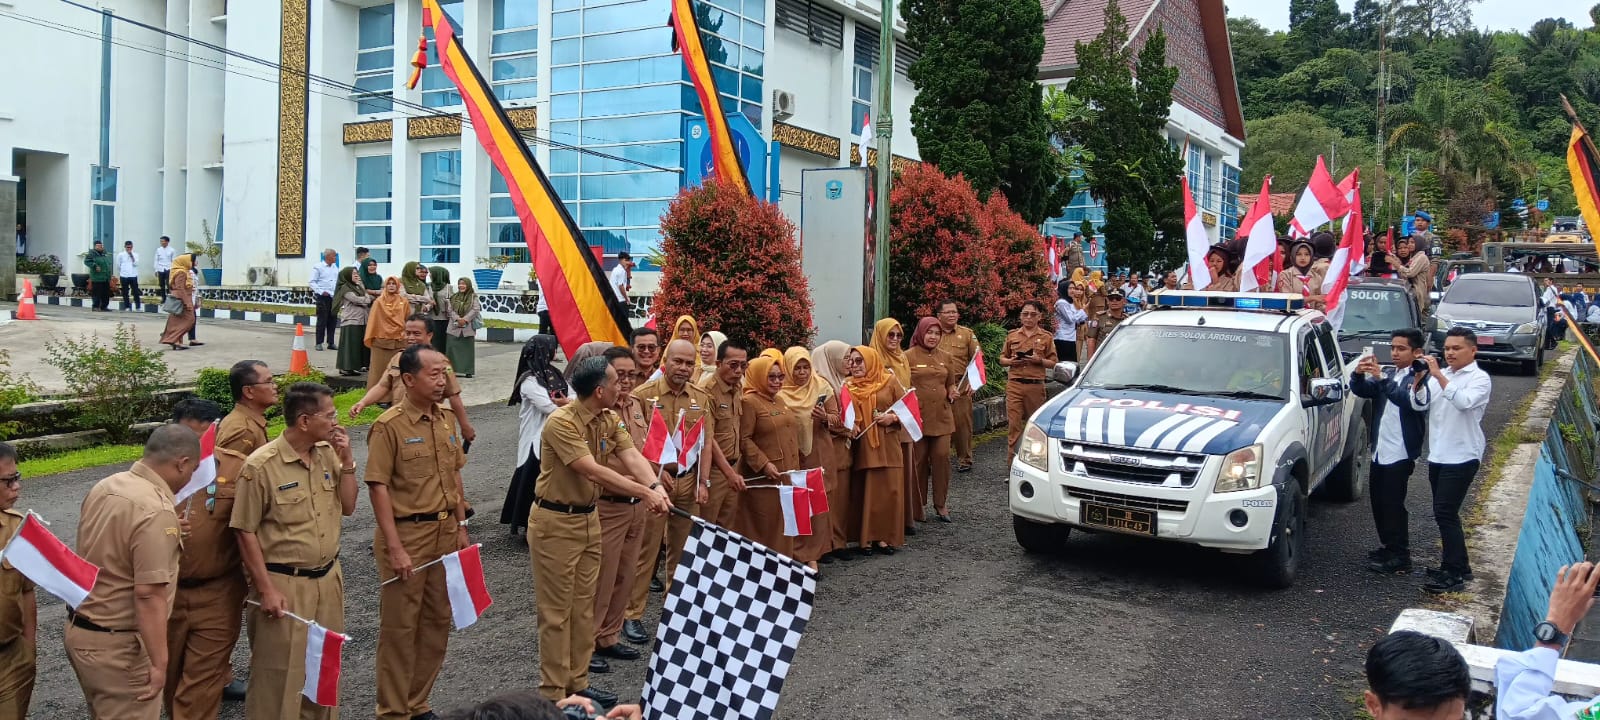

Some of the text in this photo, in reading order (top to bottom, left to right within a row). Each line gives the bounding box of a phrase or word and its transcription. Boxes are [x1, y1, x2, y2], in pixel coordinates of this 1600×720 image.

[1350, 290, 1389, 300] SOLOK
[1180, 330, 1206, 341] SOLOK
[1207, 332, 1247, 343] AROSUKA
[1079, 397, 1243, 422] POLISI
